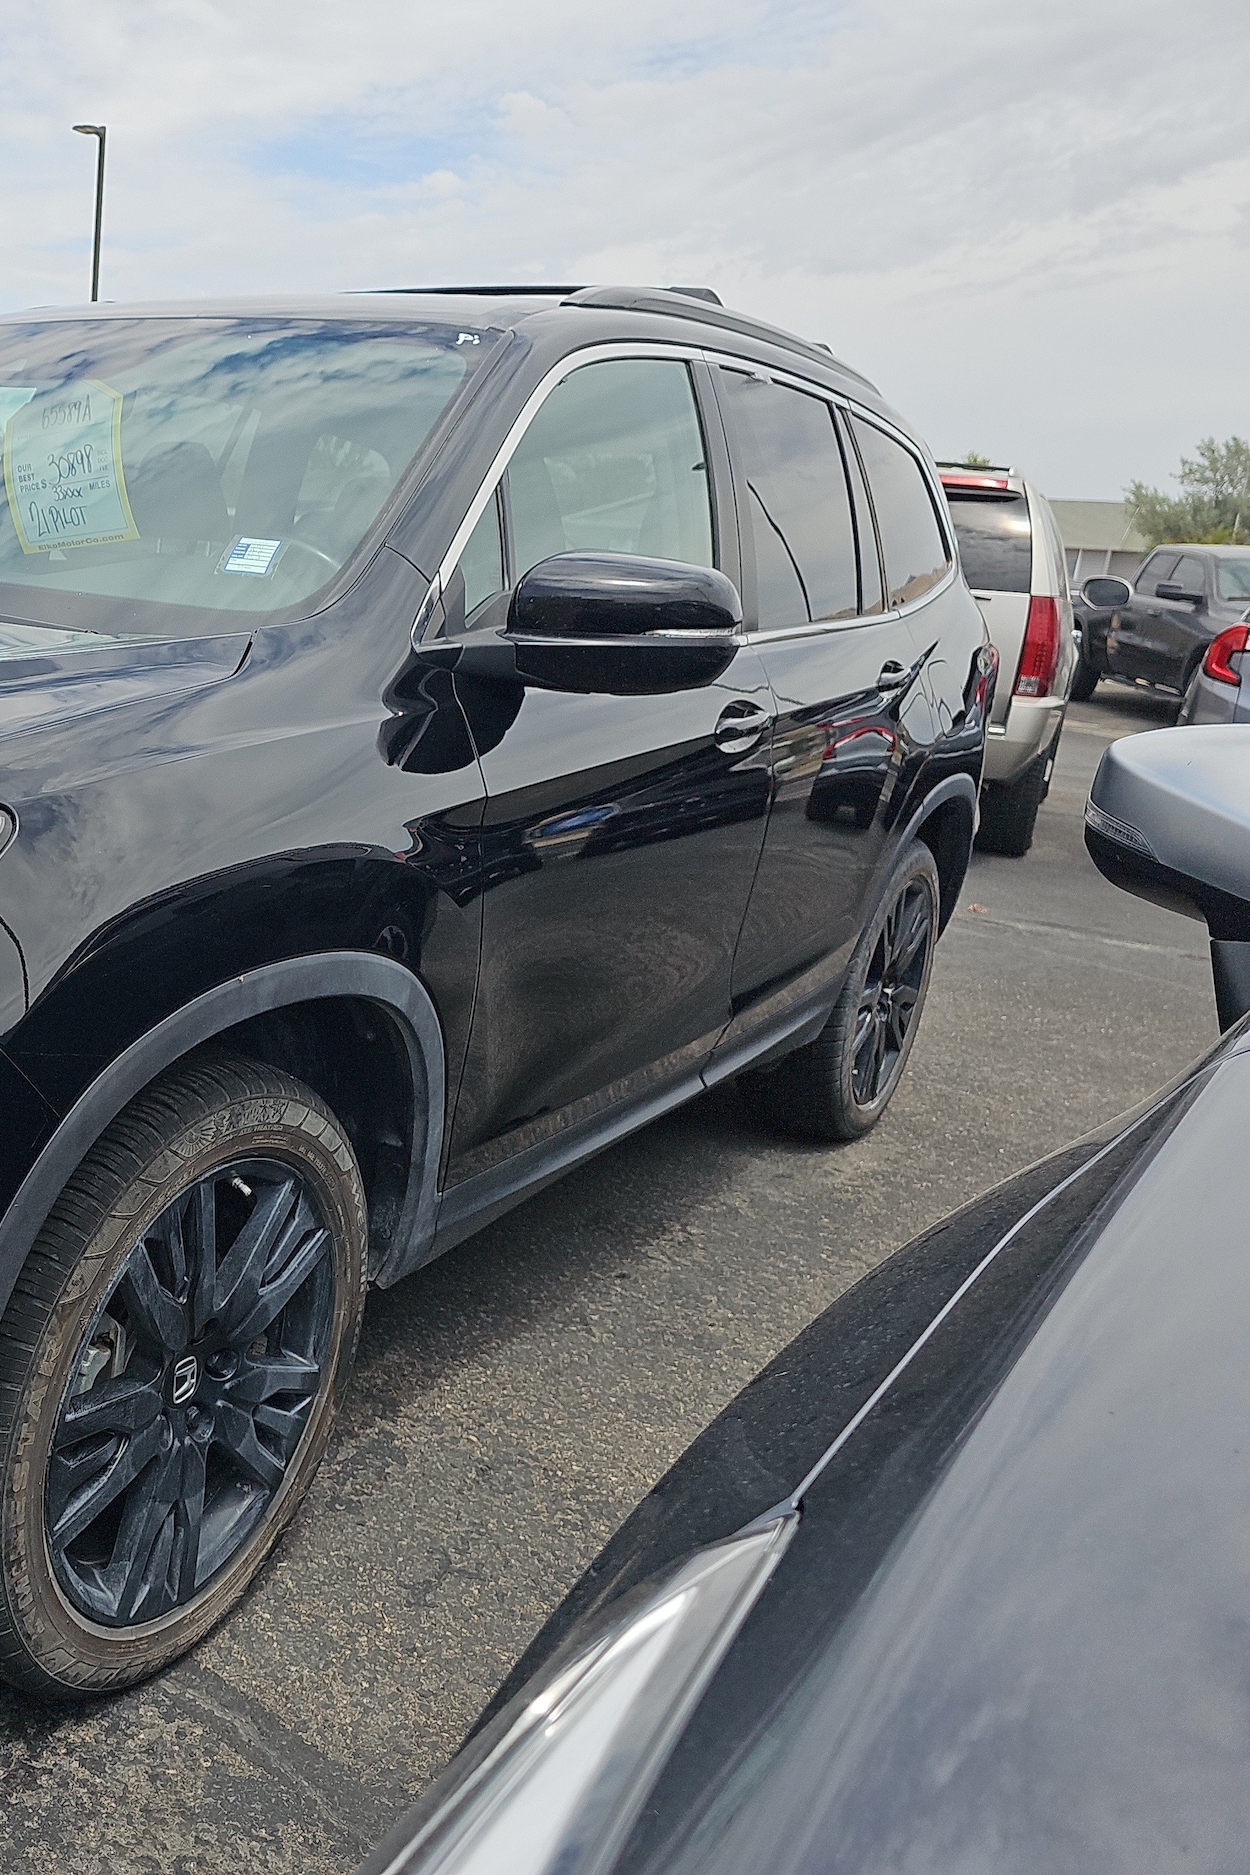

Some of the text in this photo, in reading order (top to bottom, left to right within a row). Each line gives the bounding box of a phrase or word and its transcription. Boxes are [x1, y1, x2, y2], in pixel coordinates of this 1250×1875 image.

[41, 394, 91, 429] 65589A
[17, 463, 32, 473] OUR
[47, 443, 94, 485] 30898
[18, 472, 36, 483] BEST
[89, 479, 110, 491] MILES
[48, 505, 88, 533] PILOT
[37, 533, 124, 551] ElkoMotorCo.com
